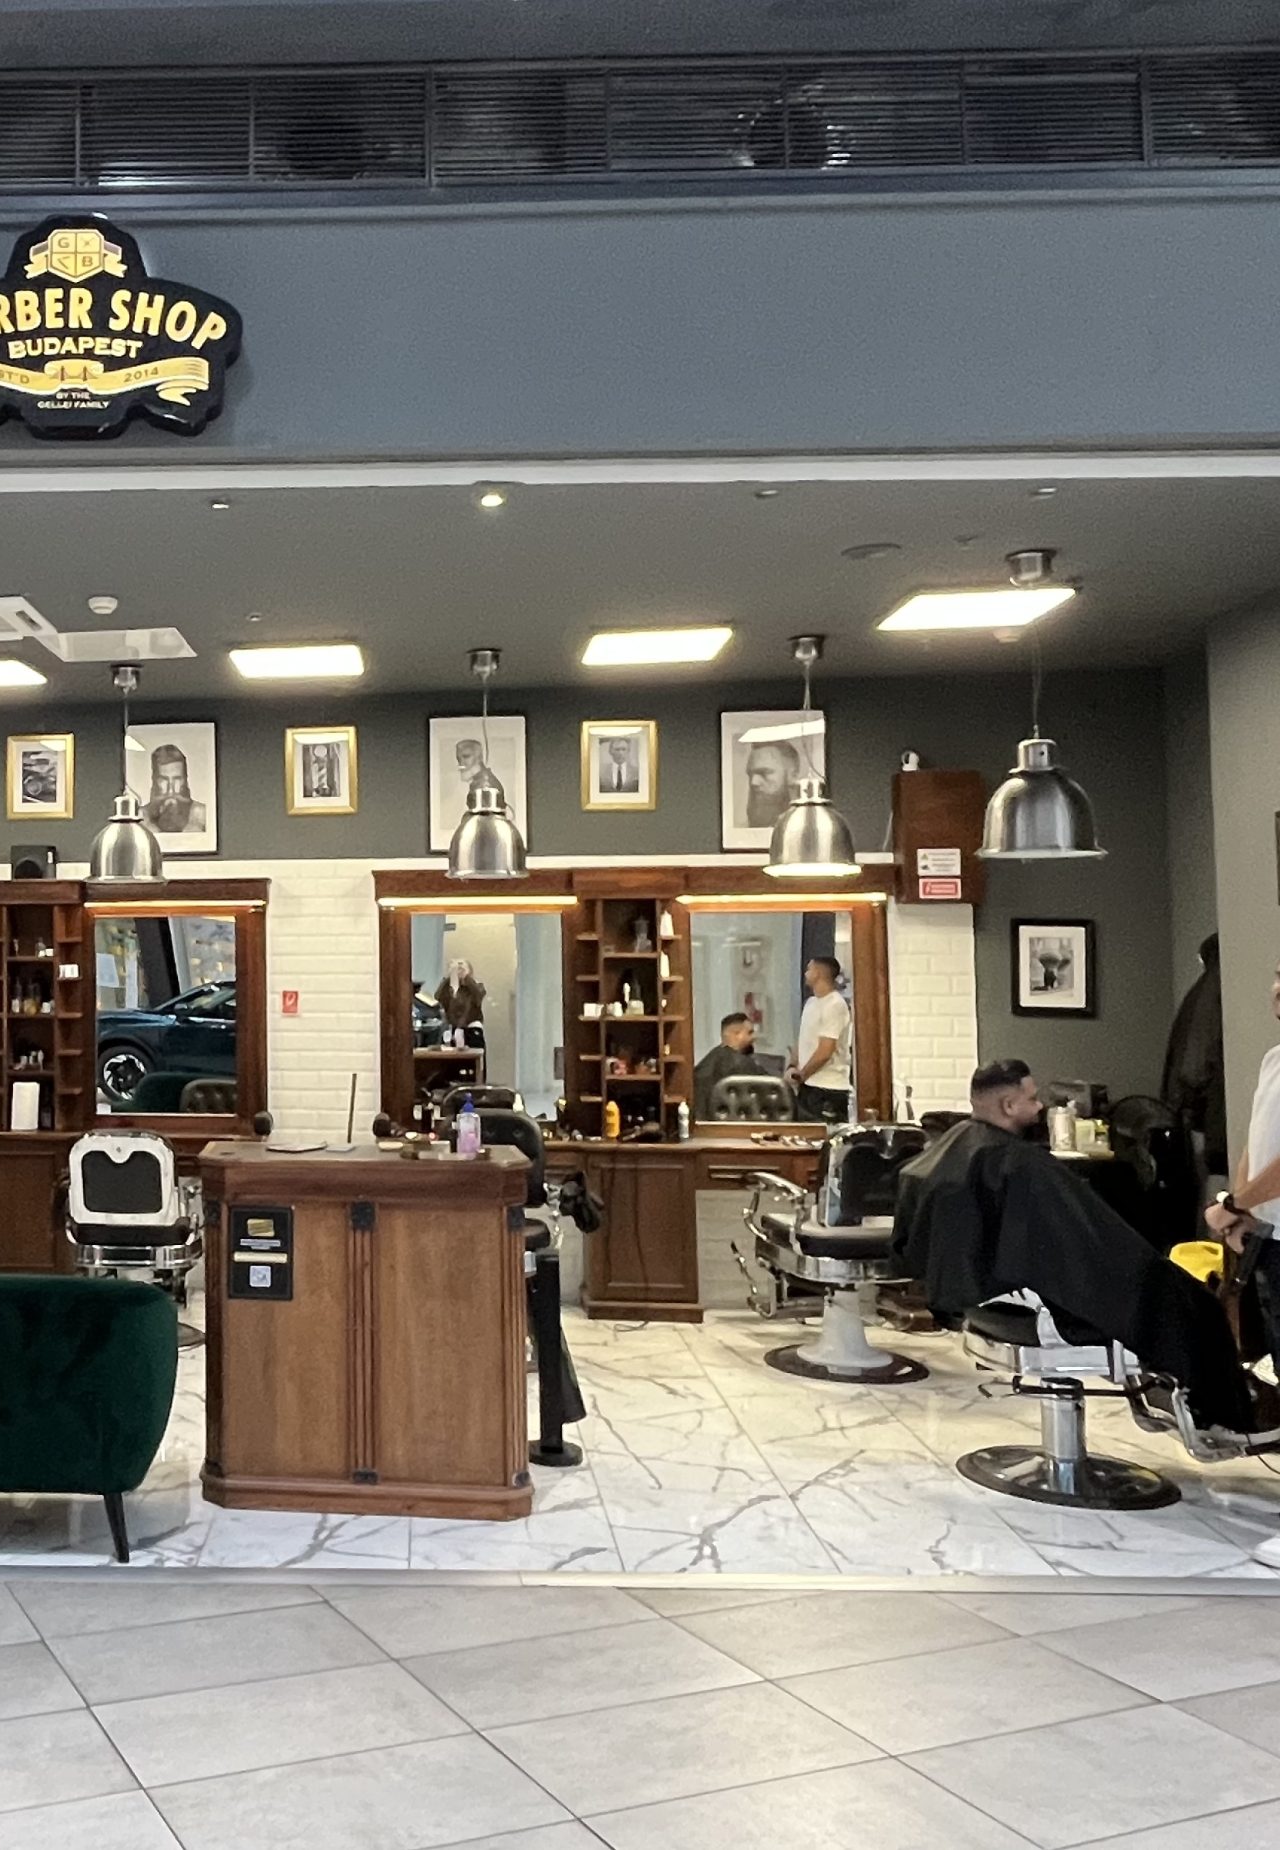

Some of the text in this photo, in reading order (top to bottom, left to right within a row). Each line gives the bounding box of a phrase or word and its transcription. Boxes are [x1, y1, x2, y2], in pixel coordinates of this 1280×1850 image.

[57, 236, 70, 249] G
[81, 255, 94, 267] B
[109, 289, 228, 350] SHOP
[7, 336, 143, 359] BUDAPEST
[123, 366, 160, 383] 2014
[55, 391, 91, 400] BY THE
[74, 400, 111, 409] FAMILY
